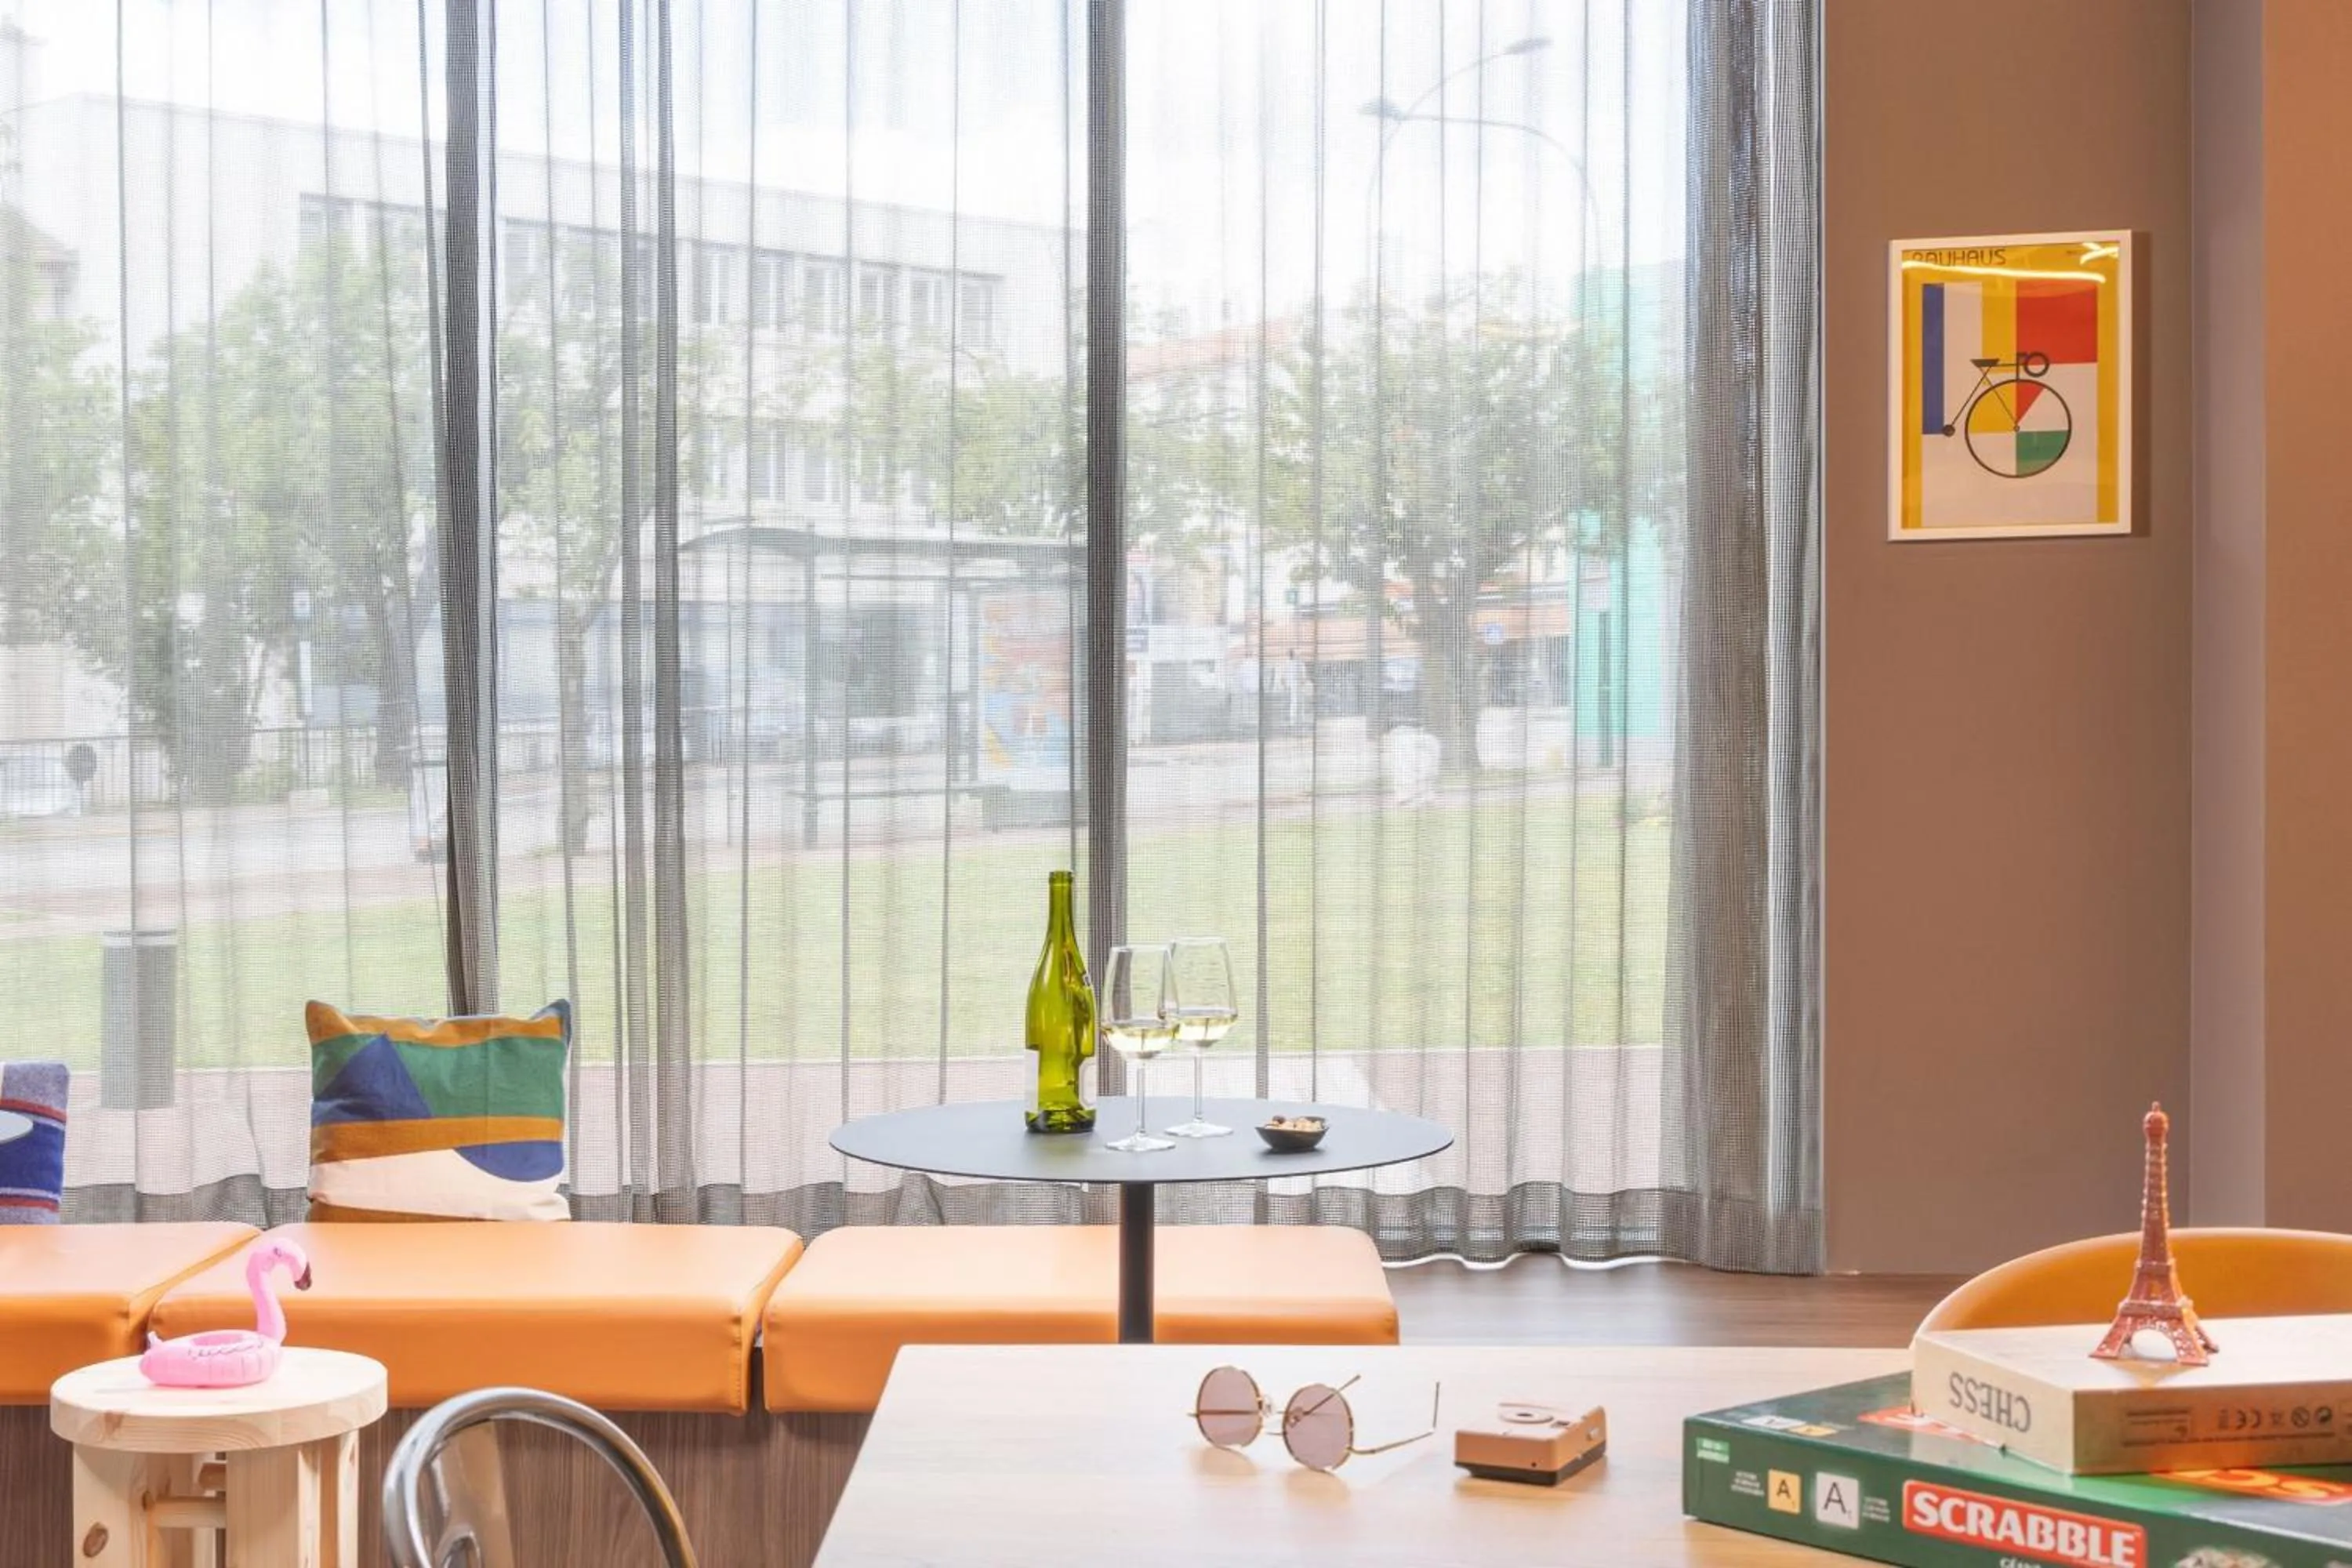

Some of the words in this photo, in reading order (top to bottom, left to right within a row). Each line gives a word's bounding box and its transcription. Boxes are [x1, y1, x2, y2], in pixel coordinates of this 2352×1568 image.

[1949, 1371, 2031, 1433] CHESS
[1776, 1479, 1791, 1499] A
[1823, 1481, 1847, 1515] A
[1913, 1491, 2135, 1568] SCRABBLE
